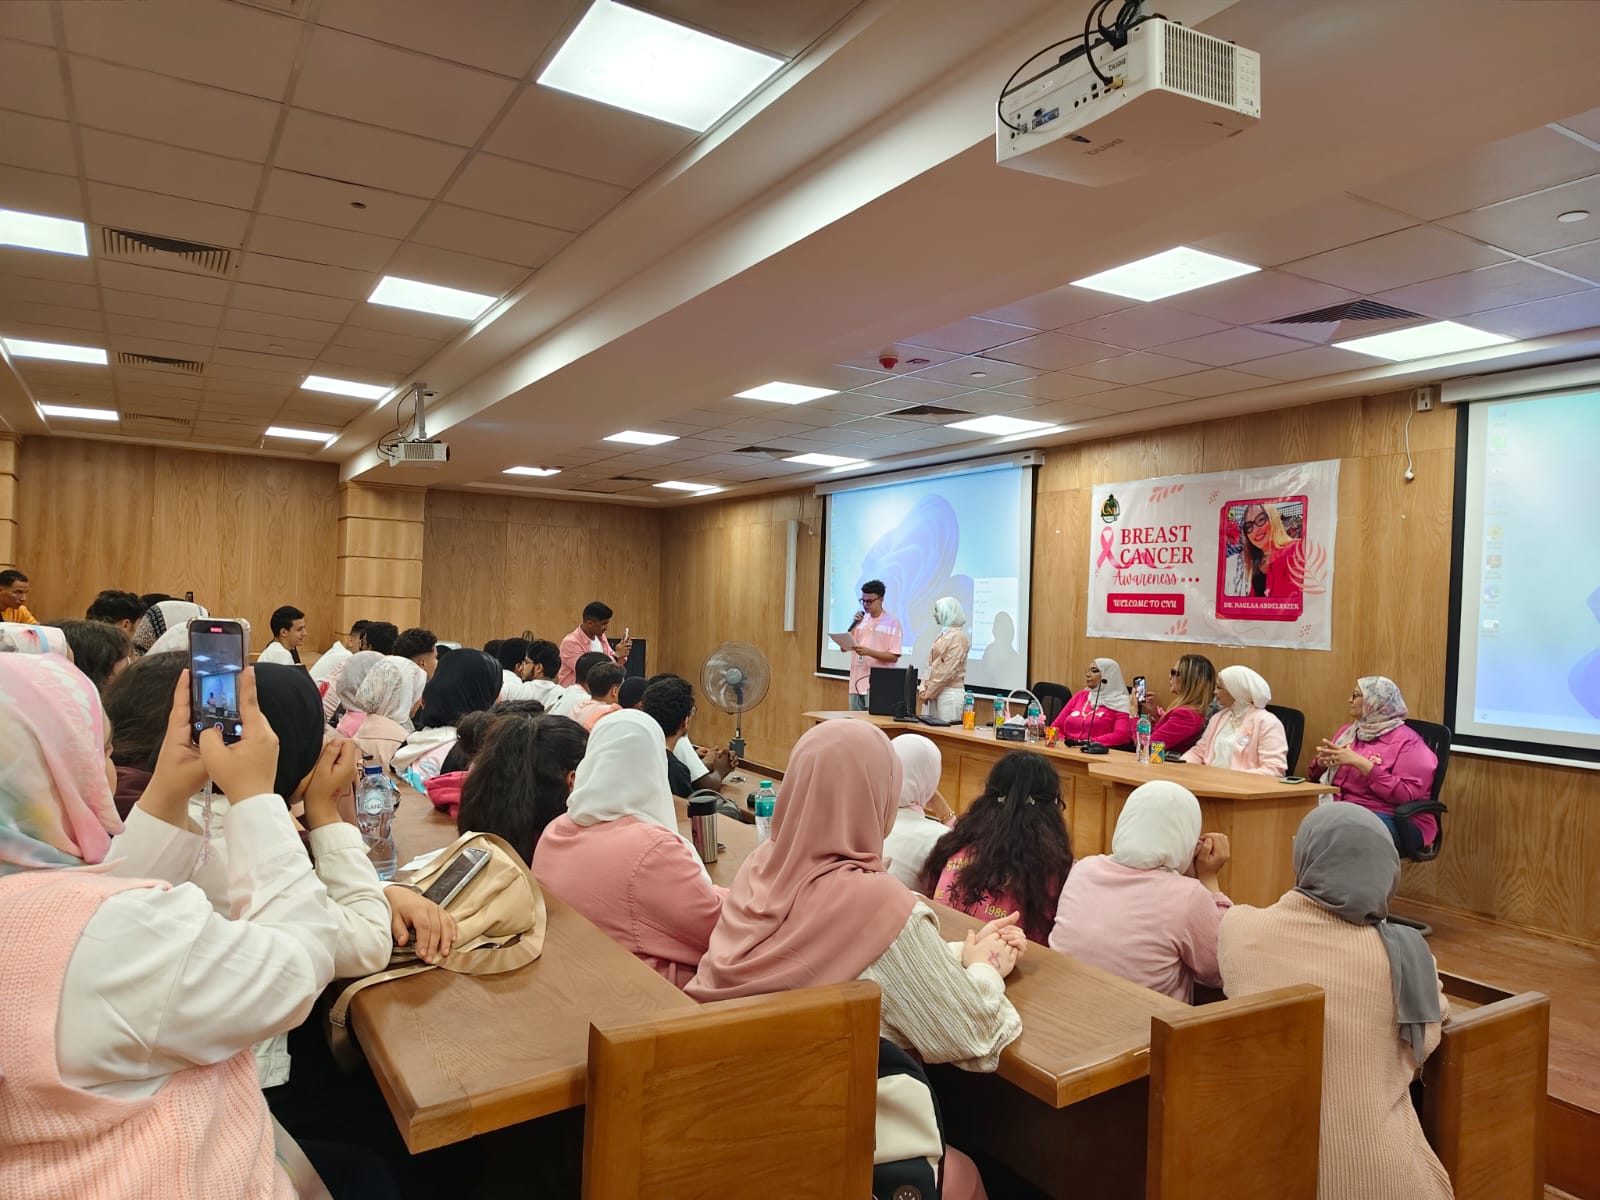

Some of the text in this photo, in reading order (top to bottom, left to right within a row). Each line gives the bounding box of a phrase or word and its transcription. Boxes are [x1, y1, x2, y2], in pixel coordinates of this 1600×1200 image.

[1120, 525, 1191, 545] BREAST
[1120, 546, 1194, 565] CANCER
[1113, 599, 1177, 608] WELCOME TO CNU
[984, 903, 1008, 919] 1986
